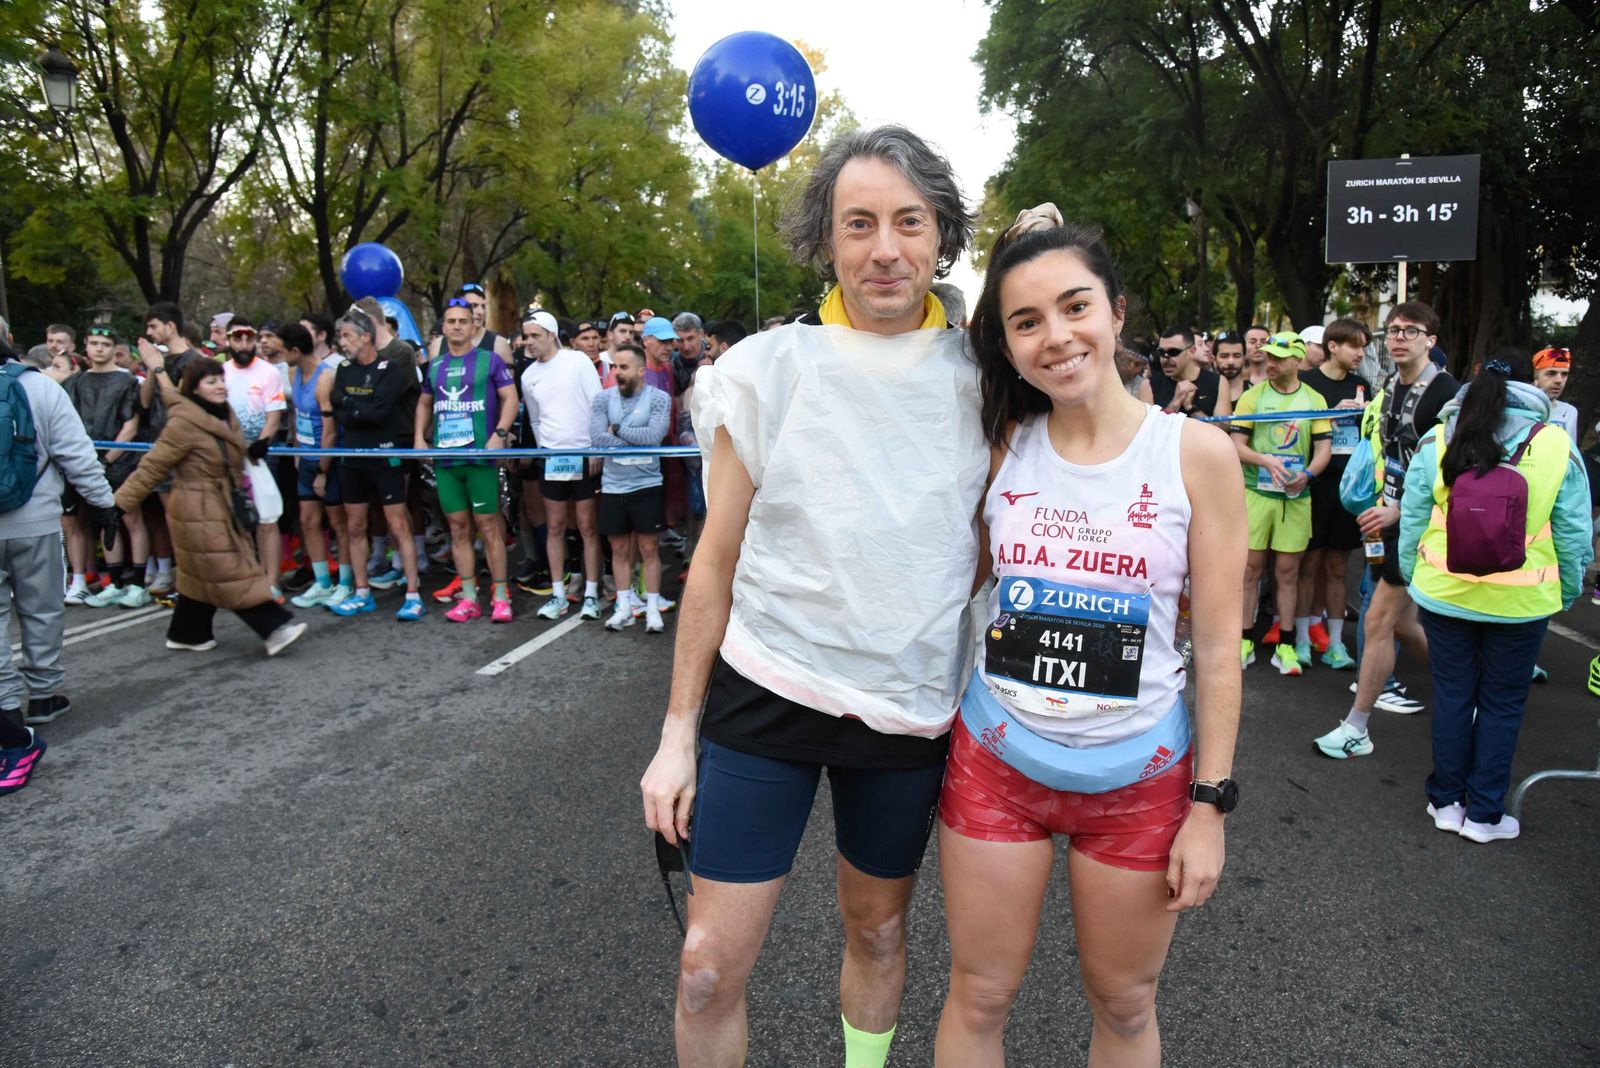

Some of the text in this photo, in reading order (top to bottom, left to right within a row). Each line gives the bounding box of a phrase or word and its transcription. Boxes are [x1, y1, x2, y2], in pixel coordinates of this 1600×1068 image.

[773, 81, 806, 118] 3:15
[1345, 175, 1462, 188] ZURICH MARATÓN DE SEVILLA
[1346, 206, 1373, 225] 3h
[1392, 204, 1419, 223] 3h
[552, 464, 577, 472] JAVIER
[1034, 507, 1089, 524] FUNDA
[1031, 522, 1075, 540] CIÓN
[1077, 534, 1109, 544] JORGE
[1078, 527, 1113, 537] GRUPO
[998, 543, 1148, 580] A.D.A. ZUERA
[1040, 588, 1130, 616] ZURICH
[1038, 629, 1084, 652] 4141
[1032, 655, 1087, 688] ITXI
[1139, 749, 1176, 779] adidas
